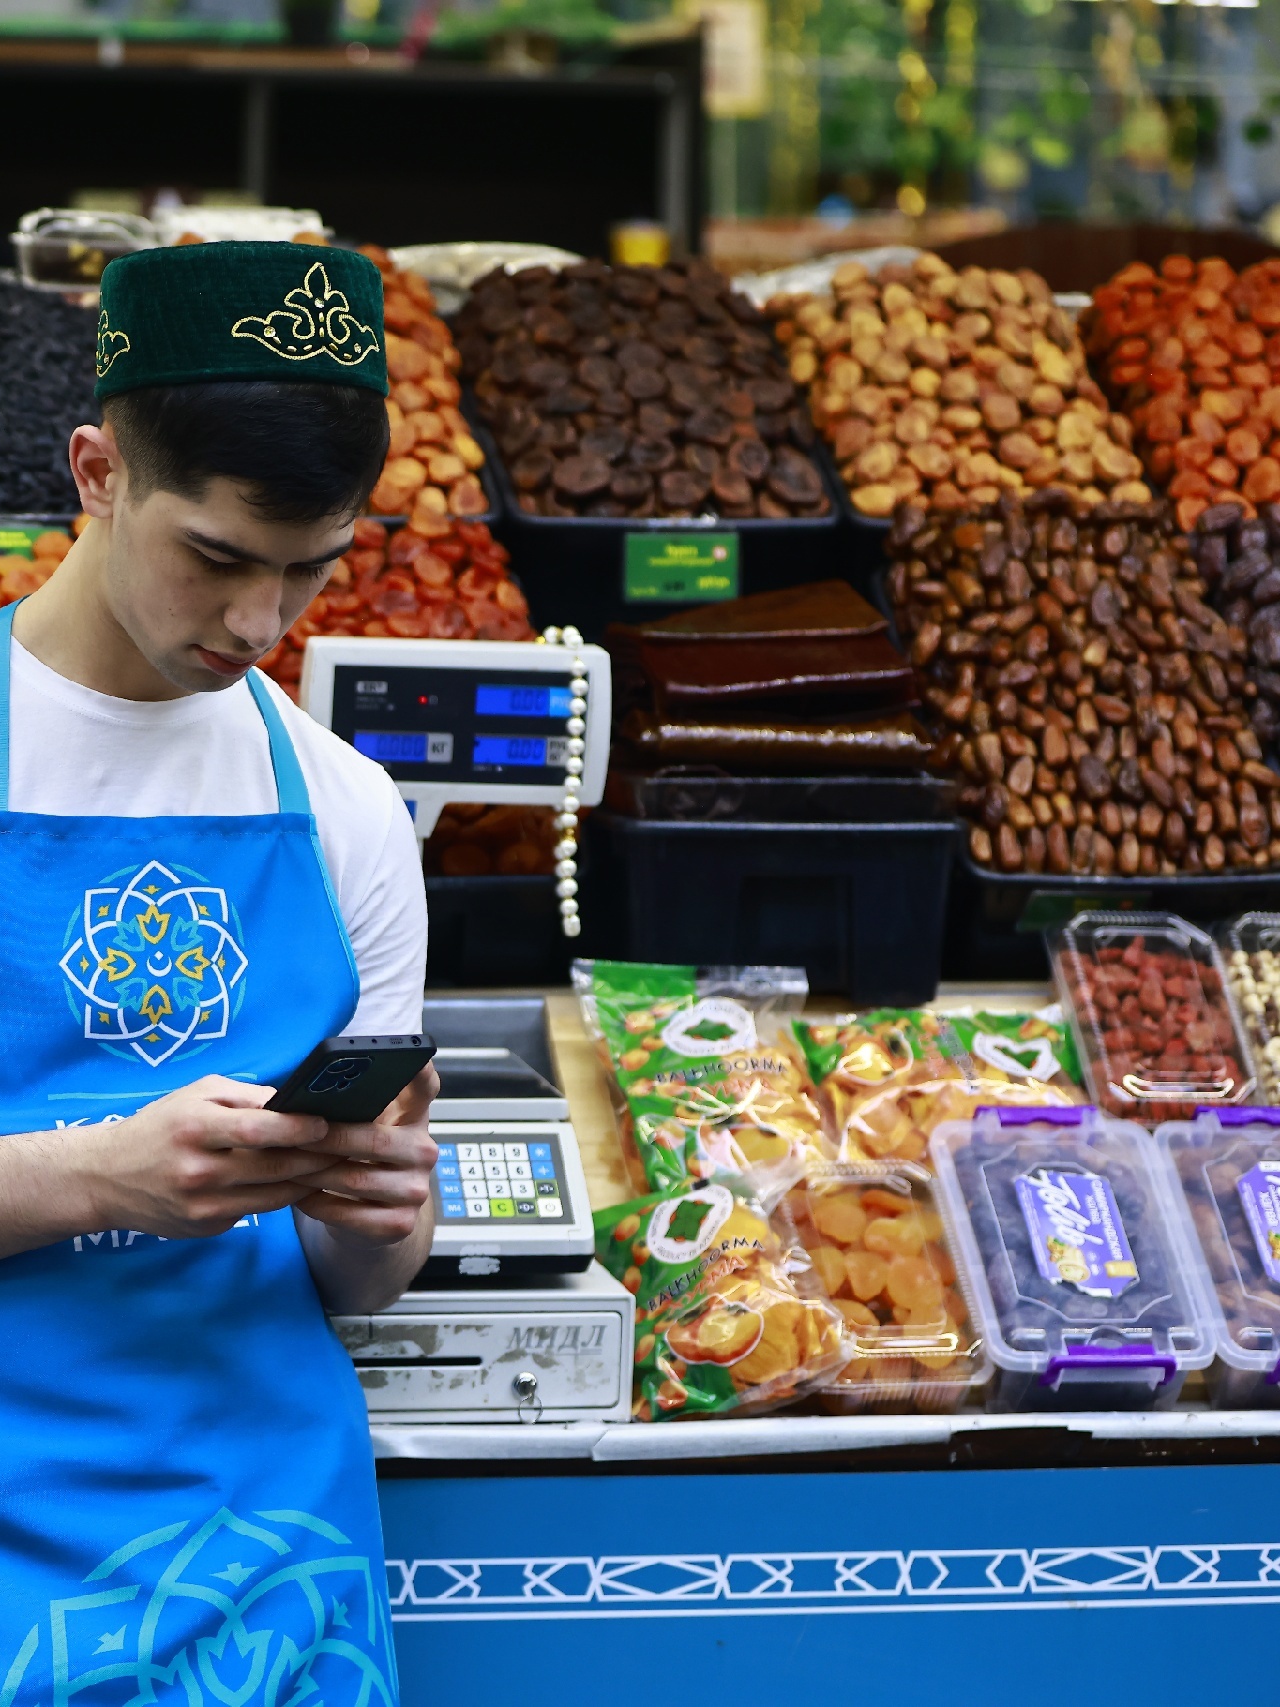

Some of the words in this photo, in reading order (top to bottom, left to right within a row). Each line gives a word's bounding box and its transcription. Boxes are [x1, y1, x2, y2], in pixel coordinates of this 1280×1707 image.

[465, 1148, 473, 1158] 7
[489, 1148, 497, 1157] 8
[513, 1148, 521, 1158] 9
[442, 1167, 456, 1176] M2
[468, 1166, 476, 1176] 4
[492, 1166, 500, 1176] 5
[516, 1166, 524, 1176] 6
[444, 1185, 459, 1193] M3
[472, 1185, 478, 1194] 1
[495, 1185, 504, 1194] 2
[519, 1185, 528, 1194] 3
[474, 1204, 482, 1213] 0
[497, 1203, 506, 1213] C
[648, 1236, 766, 1312] BALKHOORMA
